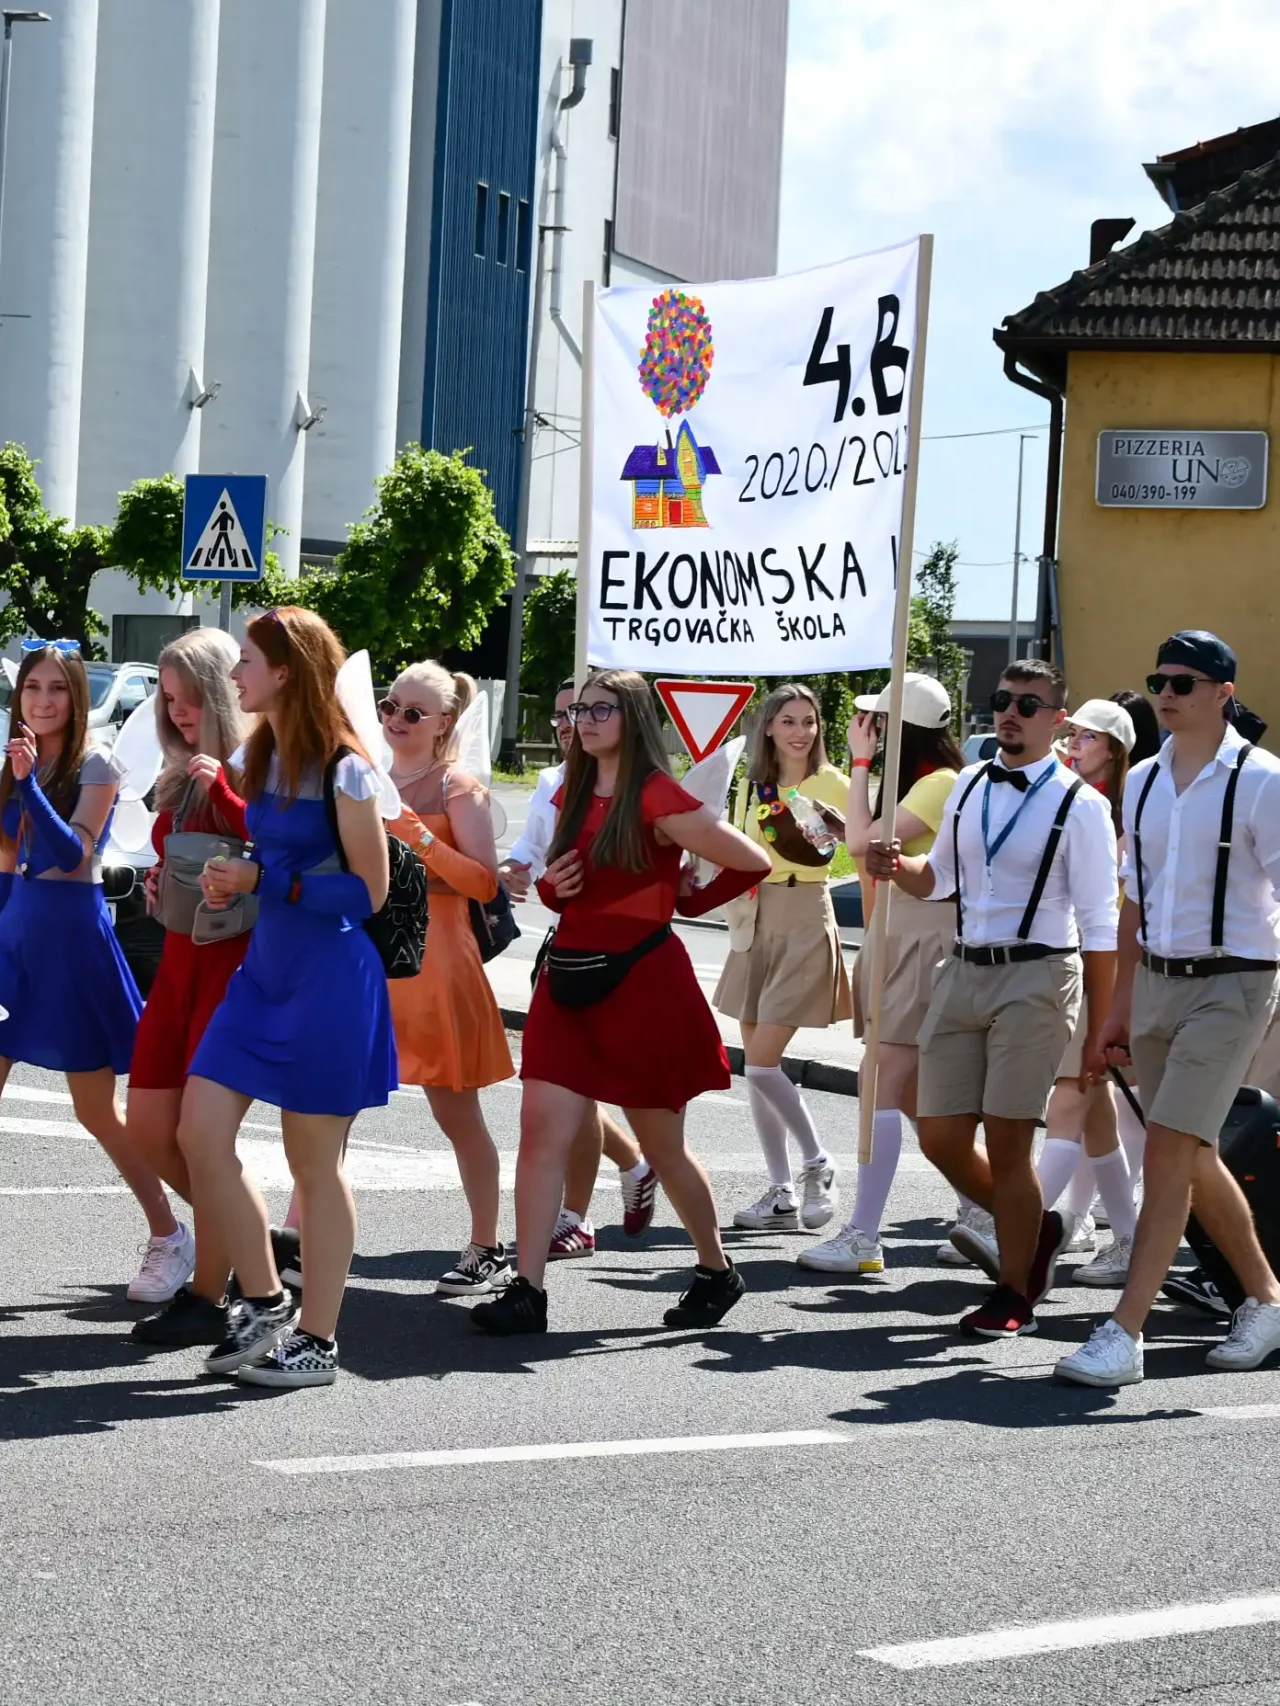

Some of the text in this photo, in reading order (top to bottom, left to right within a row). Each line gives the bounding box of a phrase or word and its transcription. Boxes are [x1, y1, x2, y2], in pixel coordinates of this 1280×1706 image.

[802, 293, 910, 423] 4.B
[1113, 439, 1206, 457] PIZZERIA
[1111, 484, 1197, 501] 040/390-199
[599, 541, 867, 610] EKONOMSKA
[602, 610, 846, 647] TRGOVAČKA ŠKOLA
